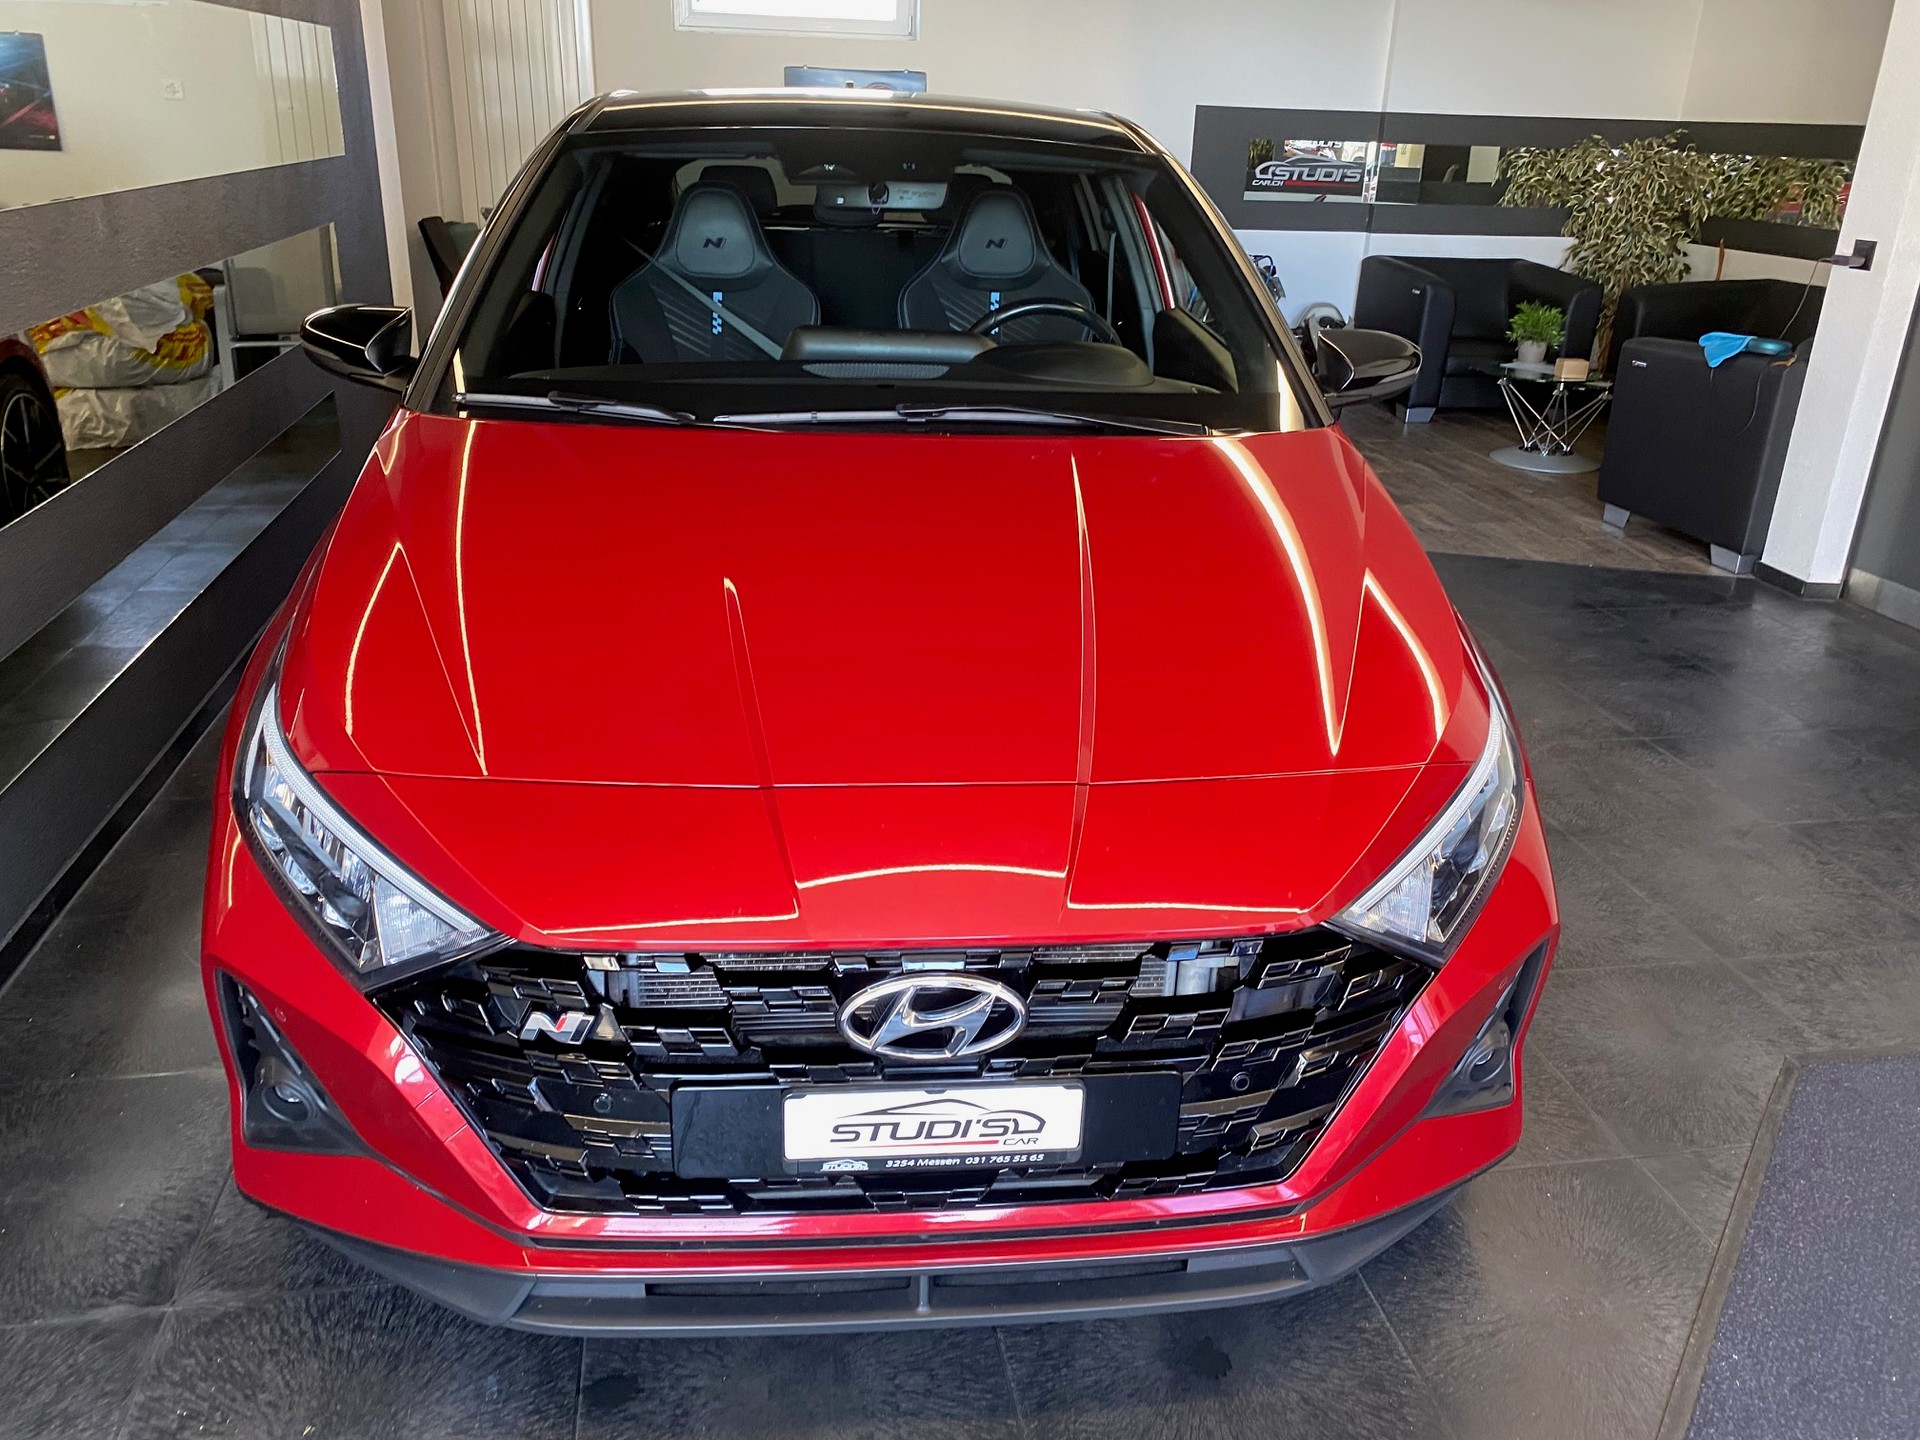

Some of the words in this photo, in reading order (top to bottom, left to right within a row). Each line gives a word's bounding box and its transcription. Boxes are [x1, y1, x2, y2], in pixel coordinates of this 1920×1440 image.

[1272, 166, 1362, 183] STUDI'S
[702, 237, 727, 249] N
[985, 238, 1008, 249] N
[519, 1010, 595, 1045] N
[829, 1117, 1013, 1143] STUDI'S
[1002, 1137, 1039, 1146] CAR
[885, 1159, 915, 1168] 3254
[916, 1158, 960, 1167] Messen
[965, 1156, 985, 1165] 031
[989, 1155, 1011, 1163] 765
[1012, 1154, 1028, 1163] 55
[1029, 1153, 1045, 1162] 65
